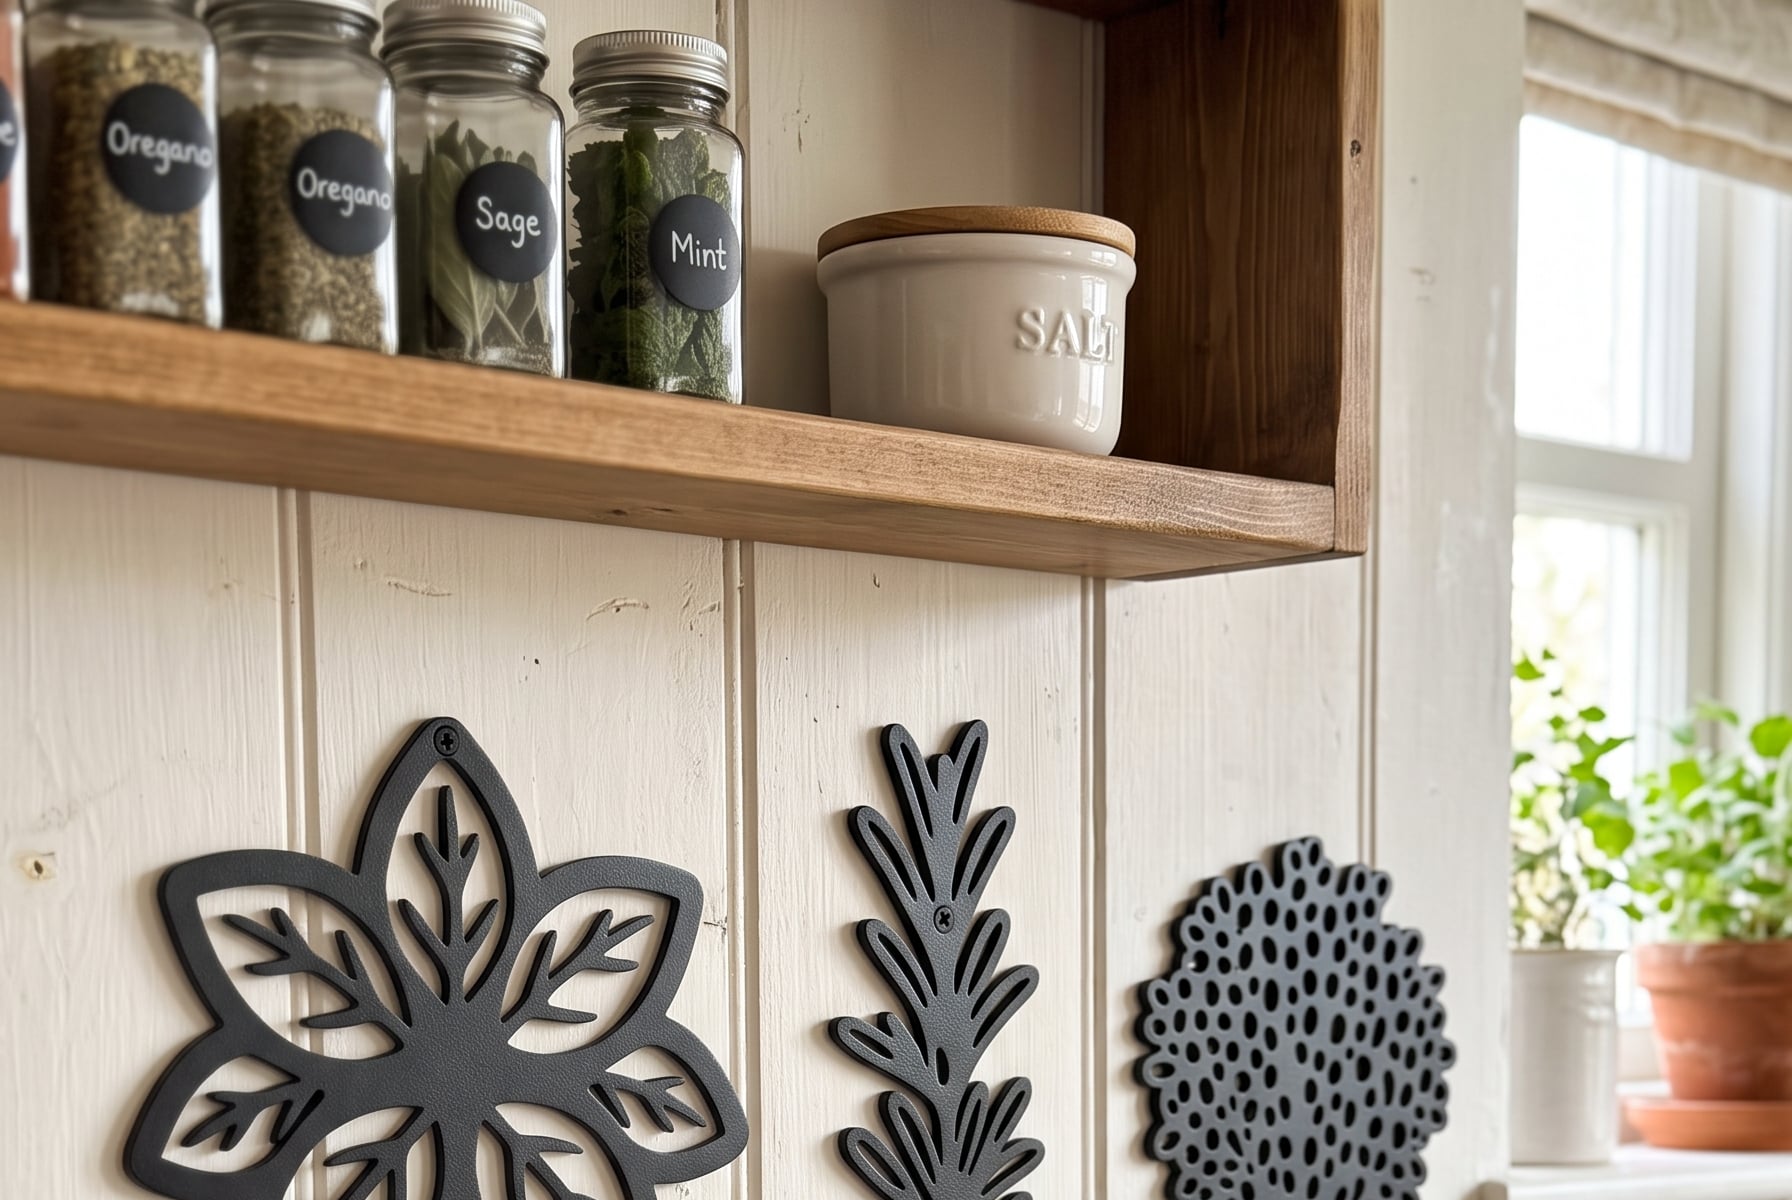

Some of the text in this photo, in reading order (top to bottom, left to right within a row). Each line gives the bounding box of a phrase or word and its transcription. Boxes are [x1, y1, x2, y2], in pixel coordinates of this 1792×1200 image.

[107, 121, 213, 174] Oregano
[297, 168, 391, 217] Oregano
[476, 196, 541, 248] Sage
[671, 230, 727, 271] Mint
